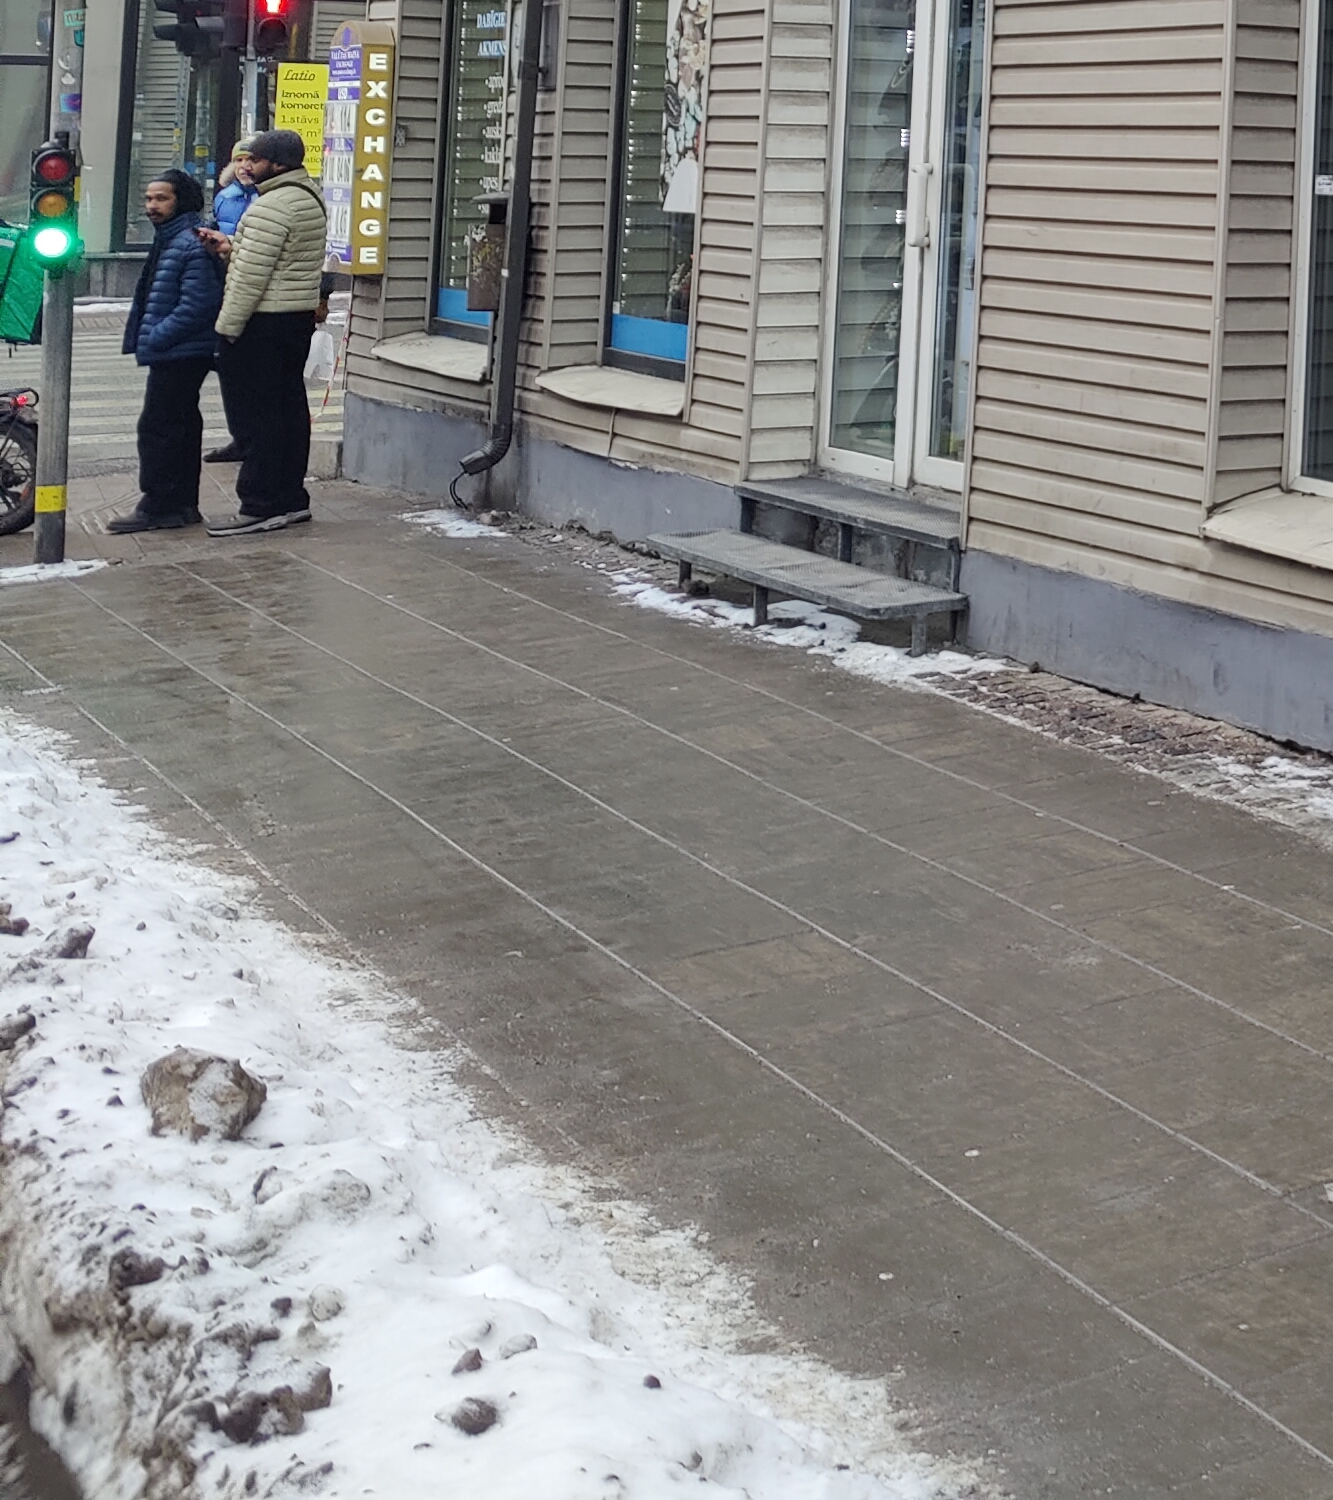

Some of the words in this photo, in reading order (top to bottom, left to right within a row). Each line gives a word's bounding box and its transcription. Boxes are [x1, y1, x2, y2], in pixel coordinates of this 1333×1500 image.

[283, 70, 316, 81] Latio
[281, 89, 320, 99] Iznomā
[358, 53, 388, 265] EXCHANGE
